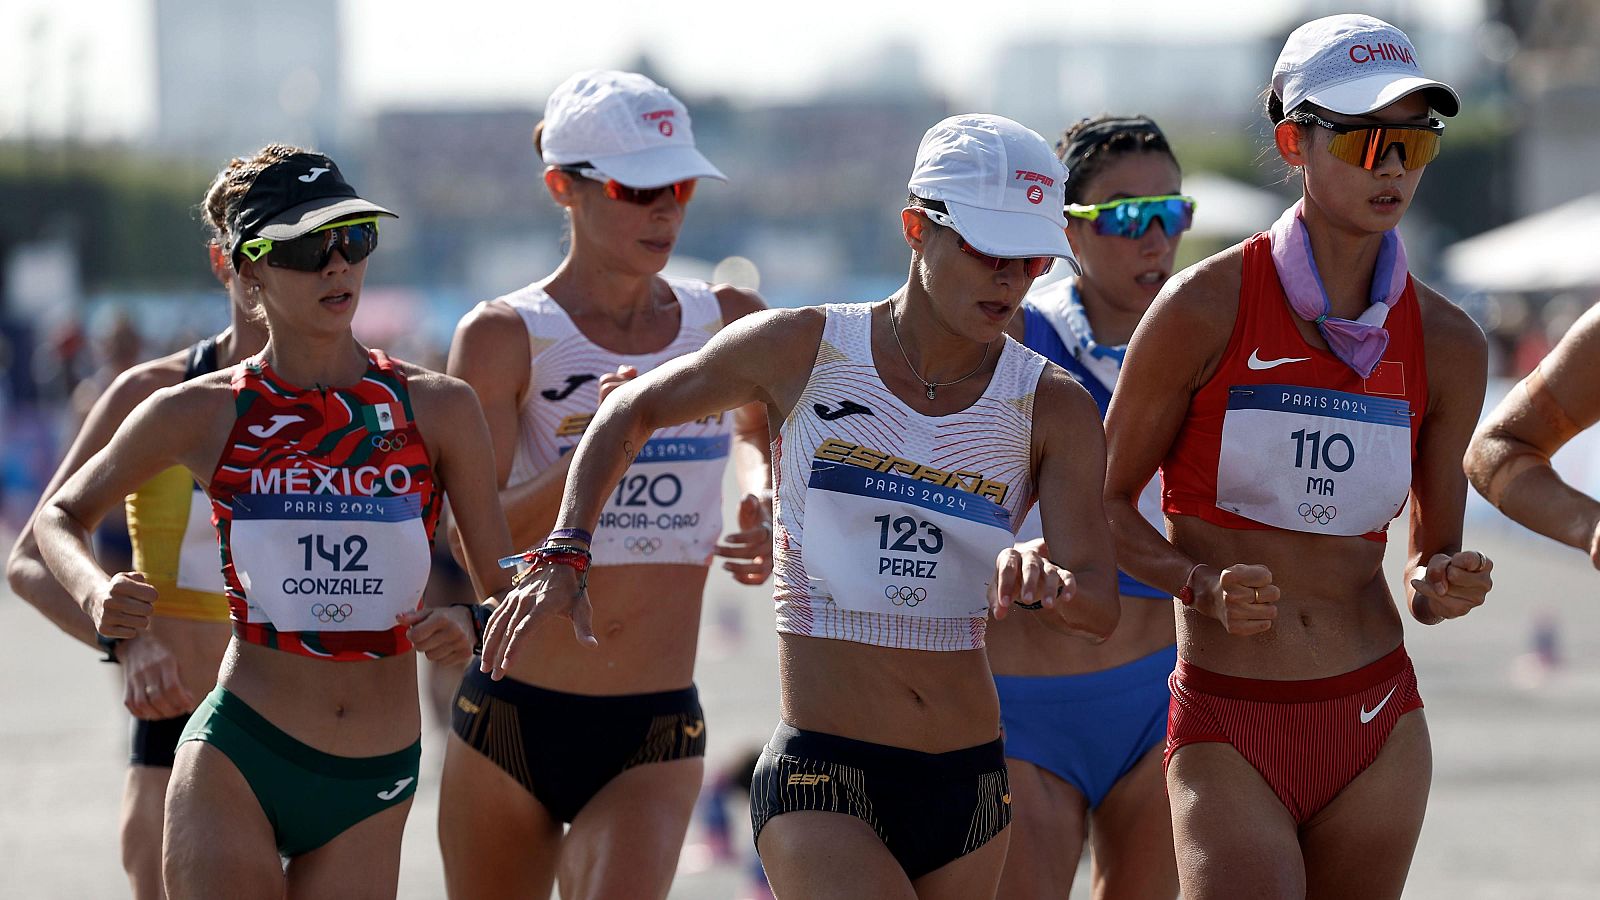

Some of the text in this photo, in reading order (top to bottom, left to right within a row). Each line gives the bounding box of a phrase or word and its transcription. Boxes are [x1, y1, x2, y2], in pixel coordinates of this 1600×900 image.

[1349, 42, 1417, 67] CHINA
[1015, 169, 1055, 188] TEAM
[1281, 392, 1367, 414] PARIS 2024
[1290, 428, 1355, 473] 110
[251, 462, 411, 497] MÉXICO
[813, 437, 1009, 505] ESPAÑA
[614, 473, 682, 507] 120
[865, 477, 967, 510] PARIS 2024
[1306, 476, 1335, 497] MA
[284, 501, 384, 515] PARIS 2024
[874, 514, 944, 554] 123
[297, 534, 369, 572] 142
[879, 557, 938, 579] PEREZ
[282, 578, 383, 595] GONZALEZ
[787, 773, 831, 786] ESP
